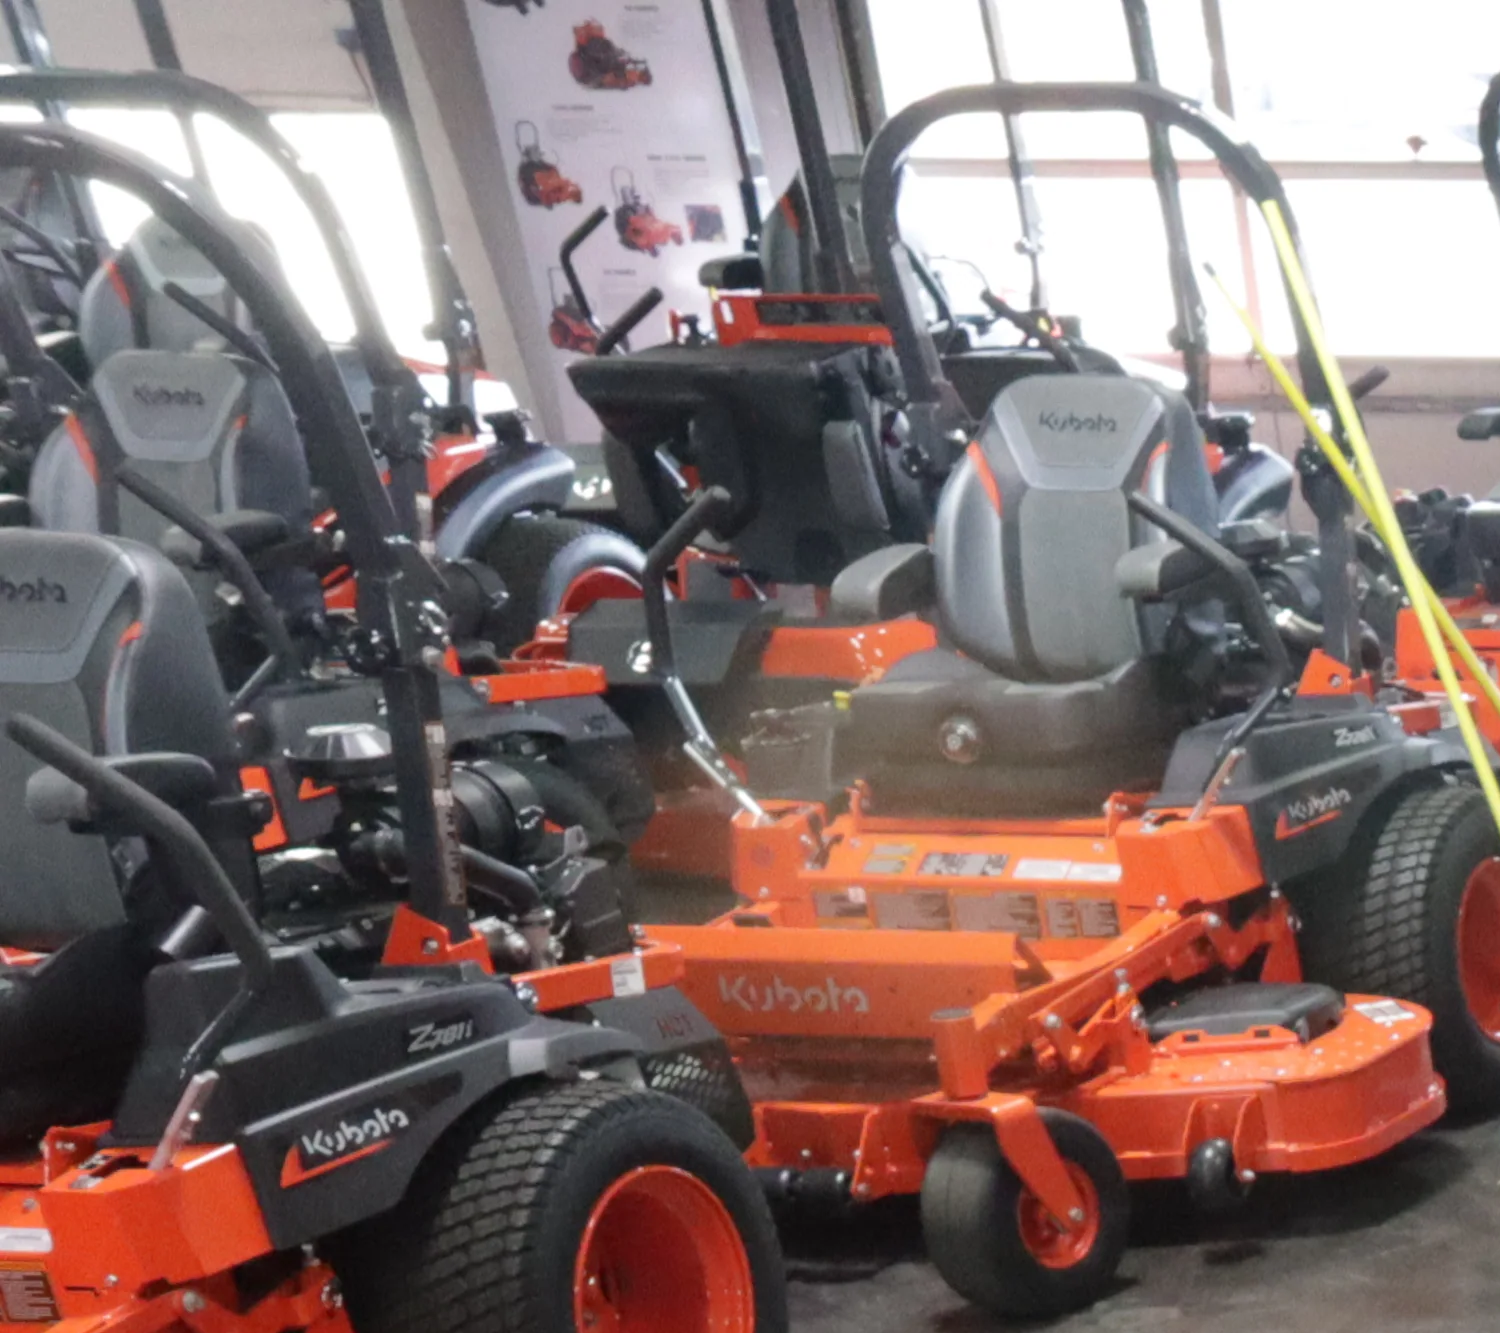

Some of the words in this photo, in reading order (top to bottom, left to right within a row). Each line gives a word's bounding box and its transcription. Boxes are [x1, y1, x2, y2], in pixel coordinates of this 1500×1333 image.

[1039, 410, 1117, 433] Kubota
[1287, 786, 1351, 820] Kubota
[718, 975, 870, 1013] Kubota
[302, 1108, 409, 1156] Kubota
